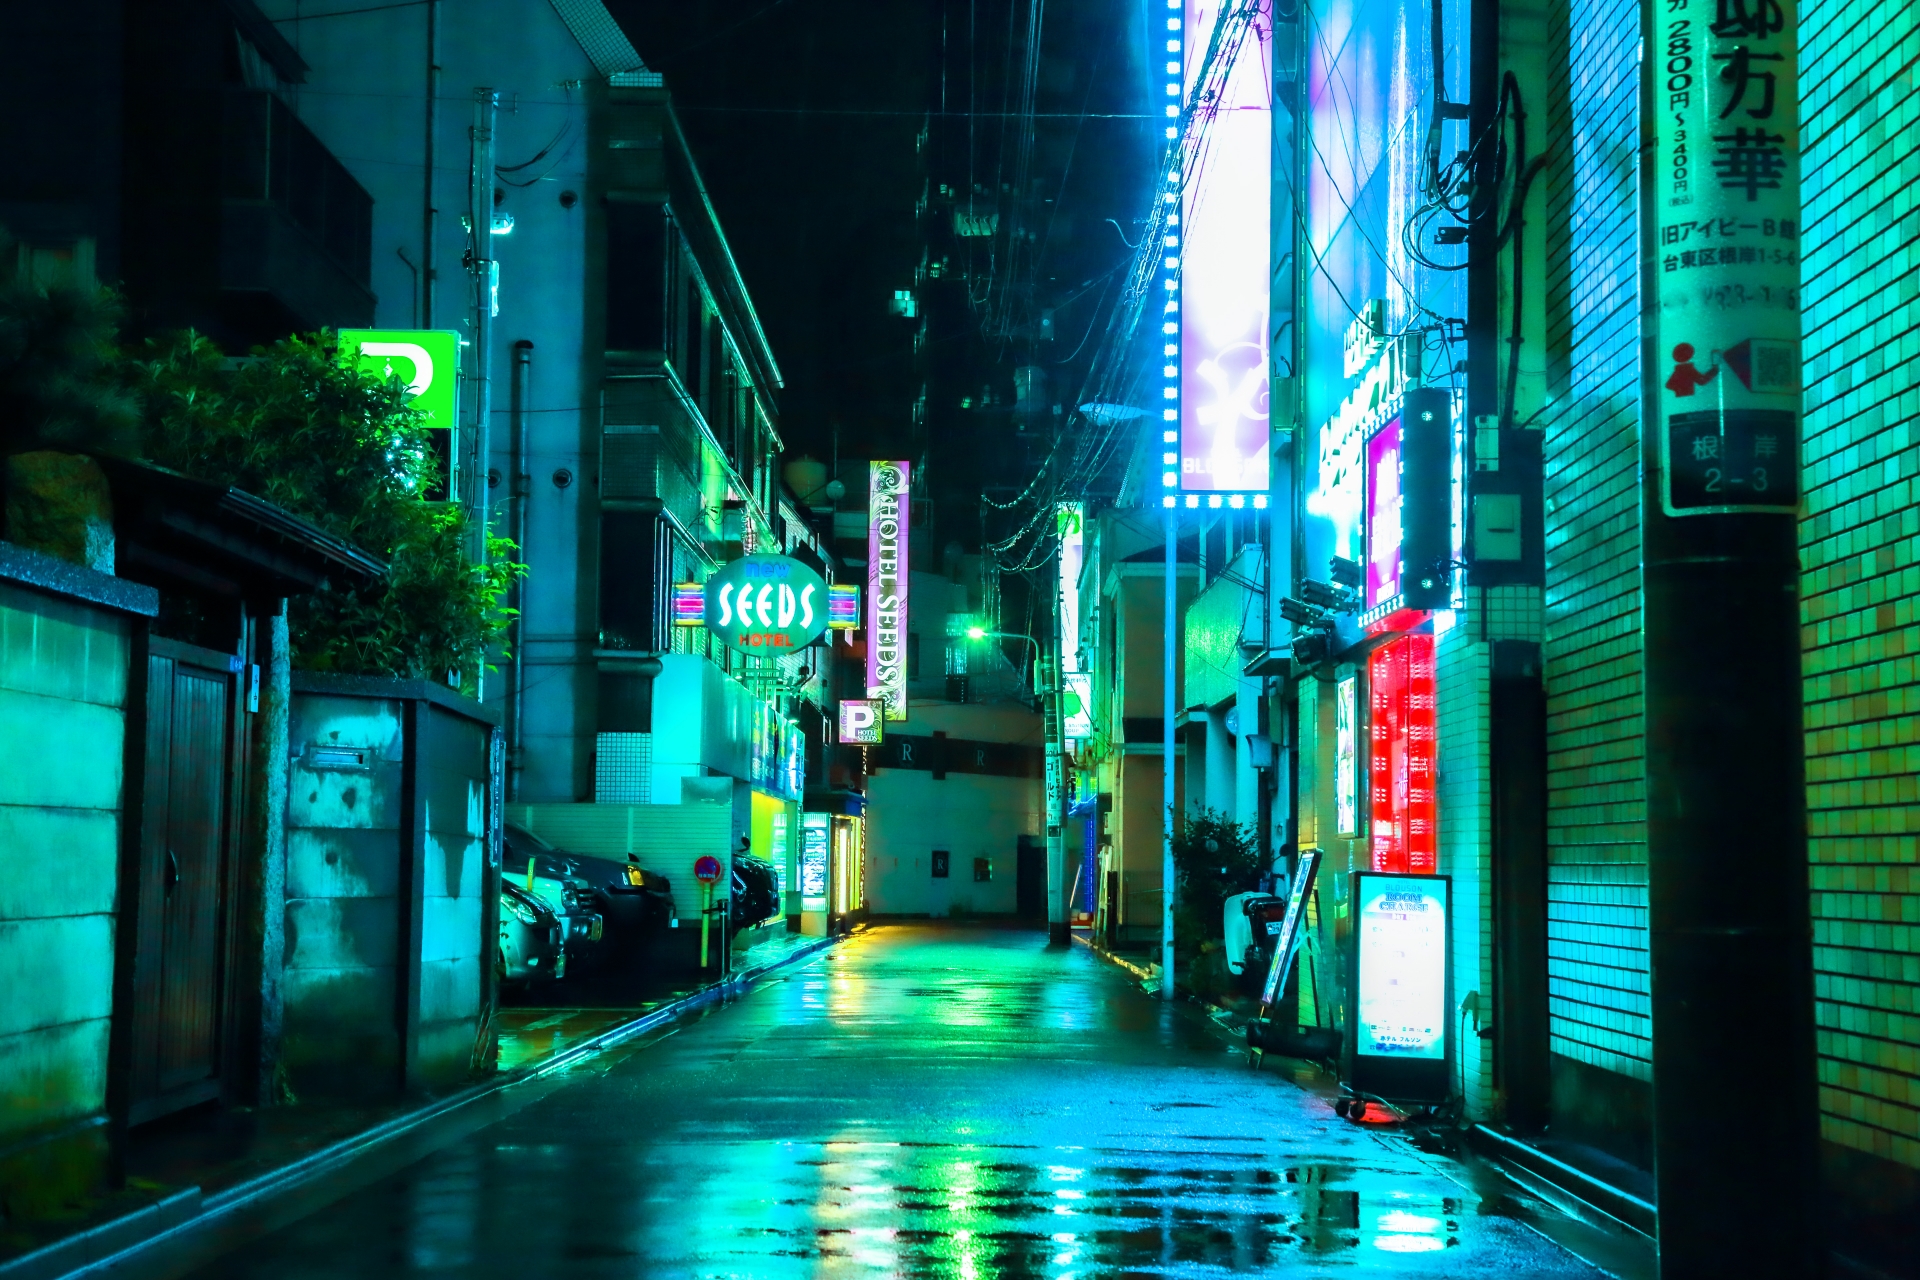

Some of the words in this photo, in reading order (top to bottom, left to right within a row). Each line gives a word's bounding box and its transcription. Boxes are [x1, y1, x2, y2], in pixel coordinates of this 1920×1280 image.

[1661, 218, 1796, 246] 旧アイビーB館
[1691, 434, 1777, 460] 根岸
[1704, 467, 1767, 492] 2-3
[879, 500, 899, 588] HOTEL
[746, 561, 790, 577] new
[718, 582, 815, 629] SEEDS
[739, 634, 794, 647] HOTEL
[876, 593, 899, 682] SEEDS
[847, 705, 875, 738] P
[902, 743, 912, 760] R
[977, 750, 984, 766] R
[1046, 762, 1055, 801] ゴールド
[937, 859, 944, 869] R
[1385, 884, 1422, 892] BLOUSON
[1385, 892, 1423, 903] ROOM
[1379, 901, 1428, 912] CHARGE
